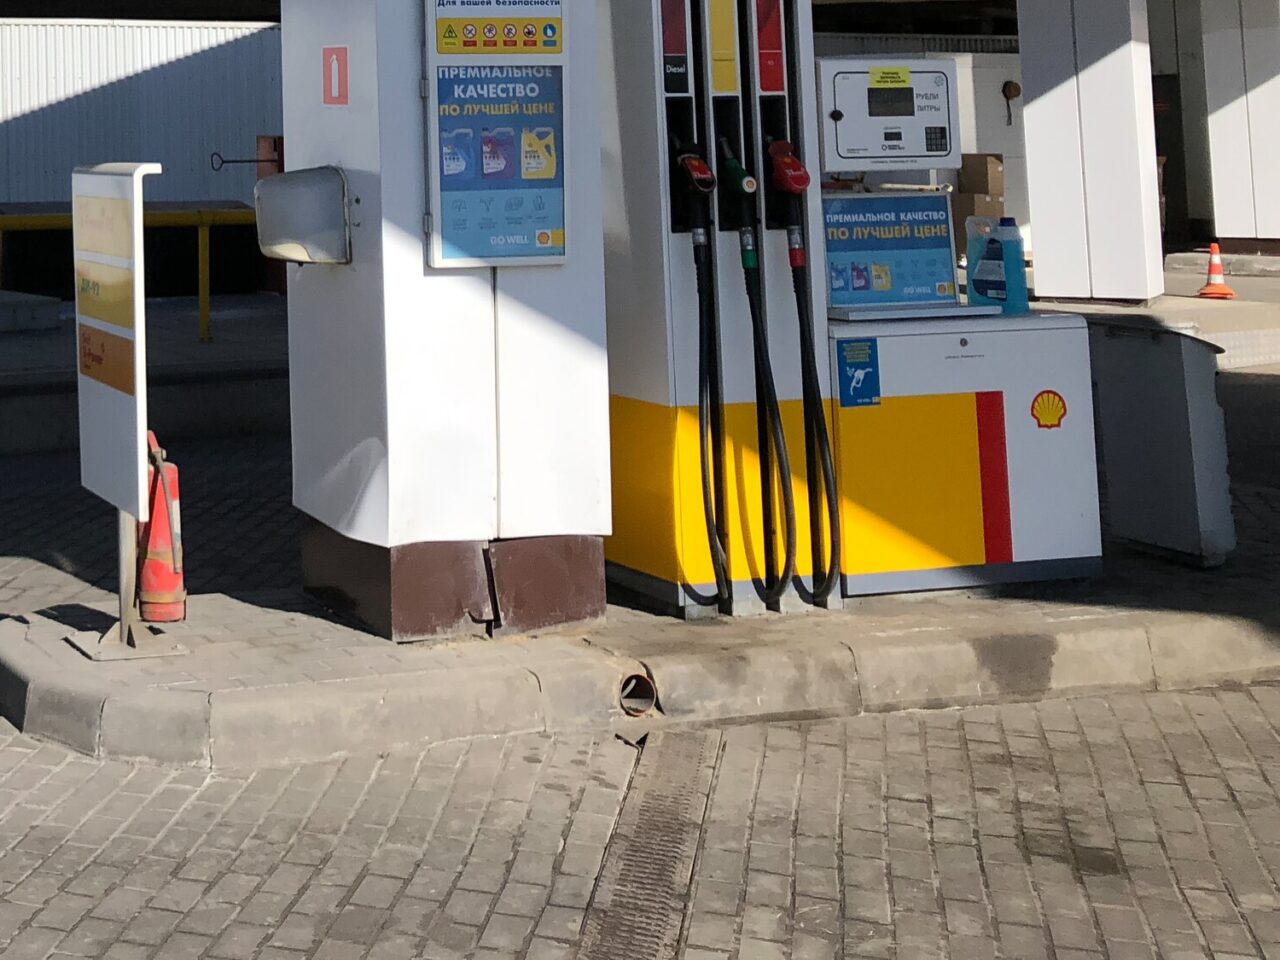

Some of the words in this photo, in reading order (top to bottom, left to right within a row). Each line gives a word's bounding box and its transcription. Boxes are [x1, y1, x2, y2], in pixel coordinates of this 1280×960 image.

[438, 66, 552, 79] ПРЕМИАЛЬНОЕ
[666, 64, 686, 73] Diesel
[454, 83, 540, 99] КАЧЕСТВО
[915, 93, 939, 101] РУБЛИ
[439, 104, 460, 116] ПО
[463, 100, 519, 116] ЛУЧШЕЙ
[522, 103, 555, 116] ЦЕНЕ
[916, 104, 941, 113] ЛИТРЫ
[826, 212, 896, 223] ПРЕМИАЛЬНОЕ
[900, 211, 946, 221] КАЧЕСТВО
[827, 227, 849, 240] ПО
[853, 223, 911, 240] ЛУЧШЕЙ
[914, 224, 949, 239] ЦЕНЕ
[490, 236, 506, 246] GO
[506, 235, 529, 245] WELL
